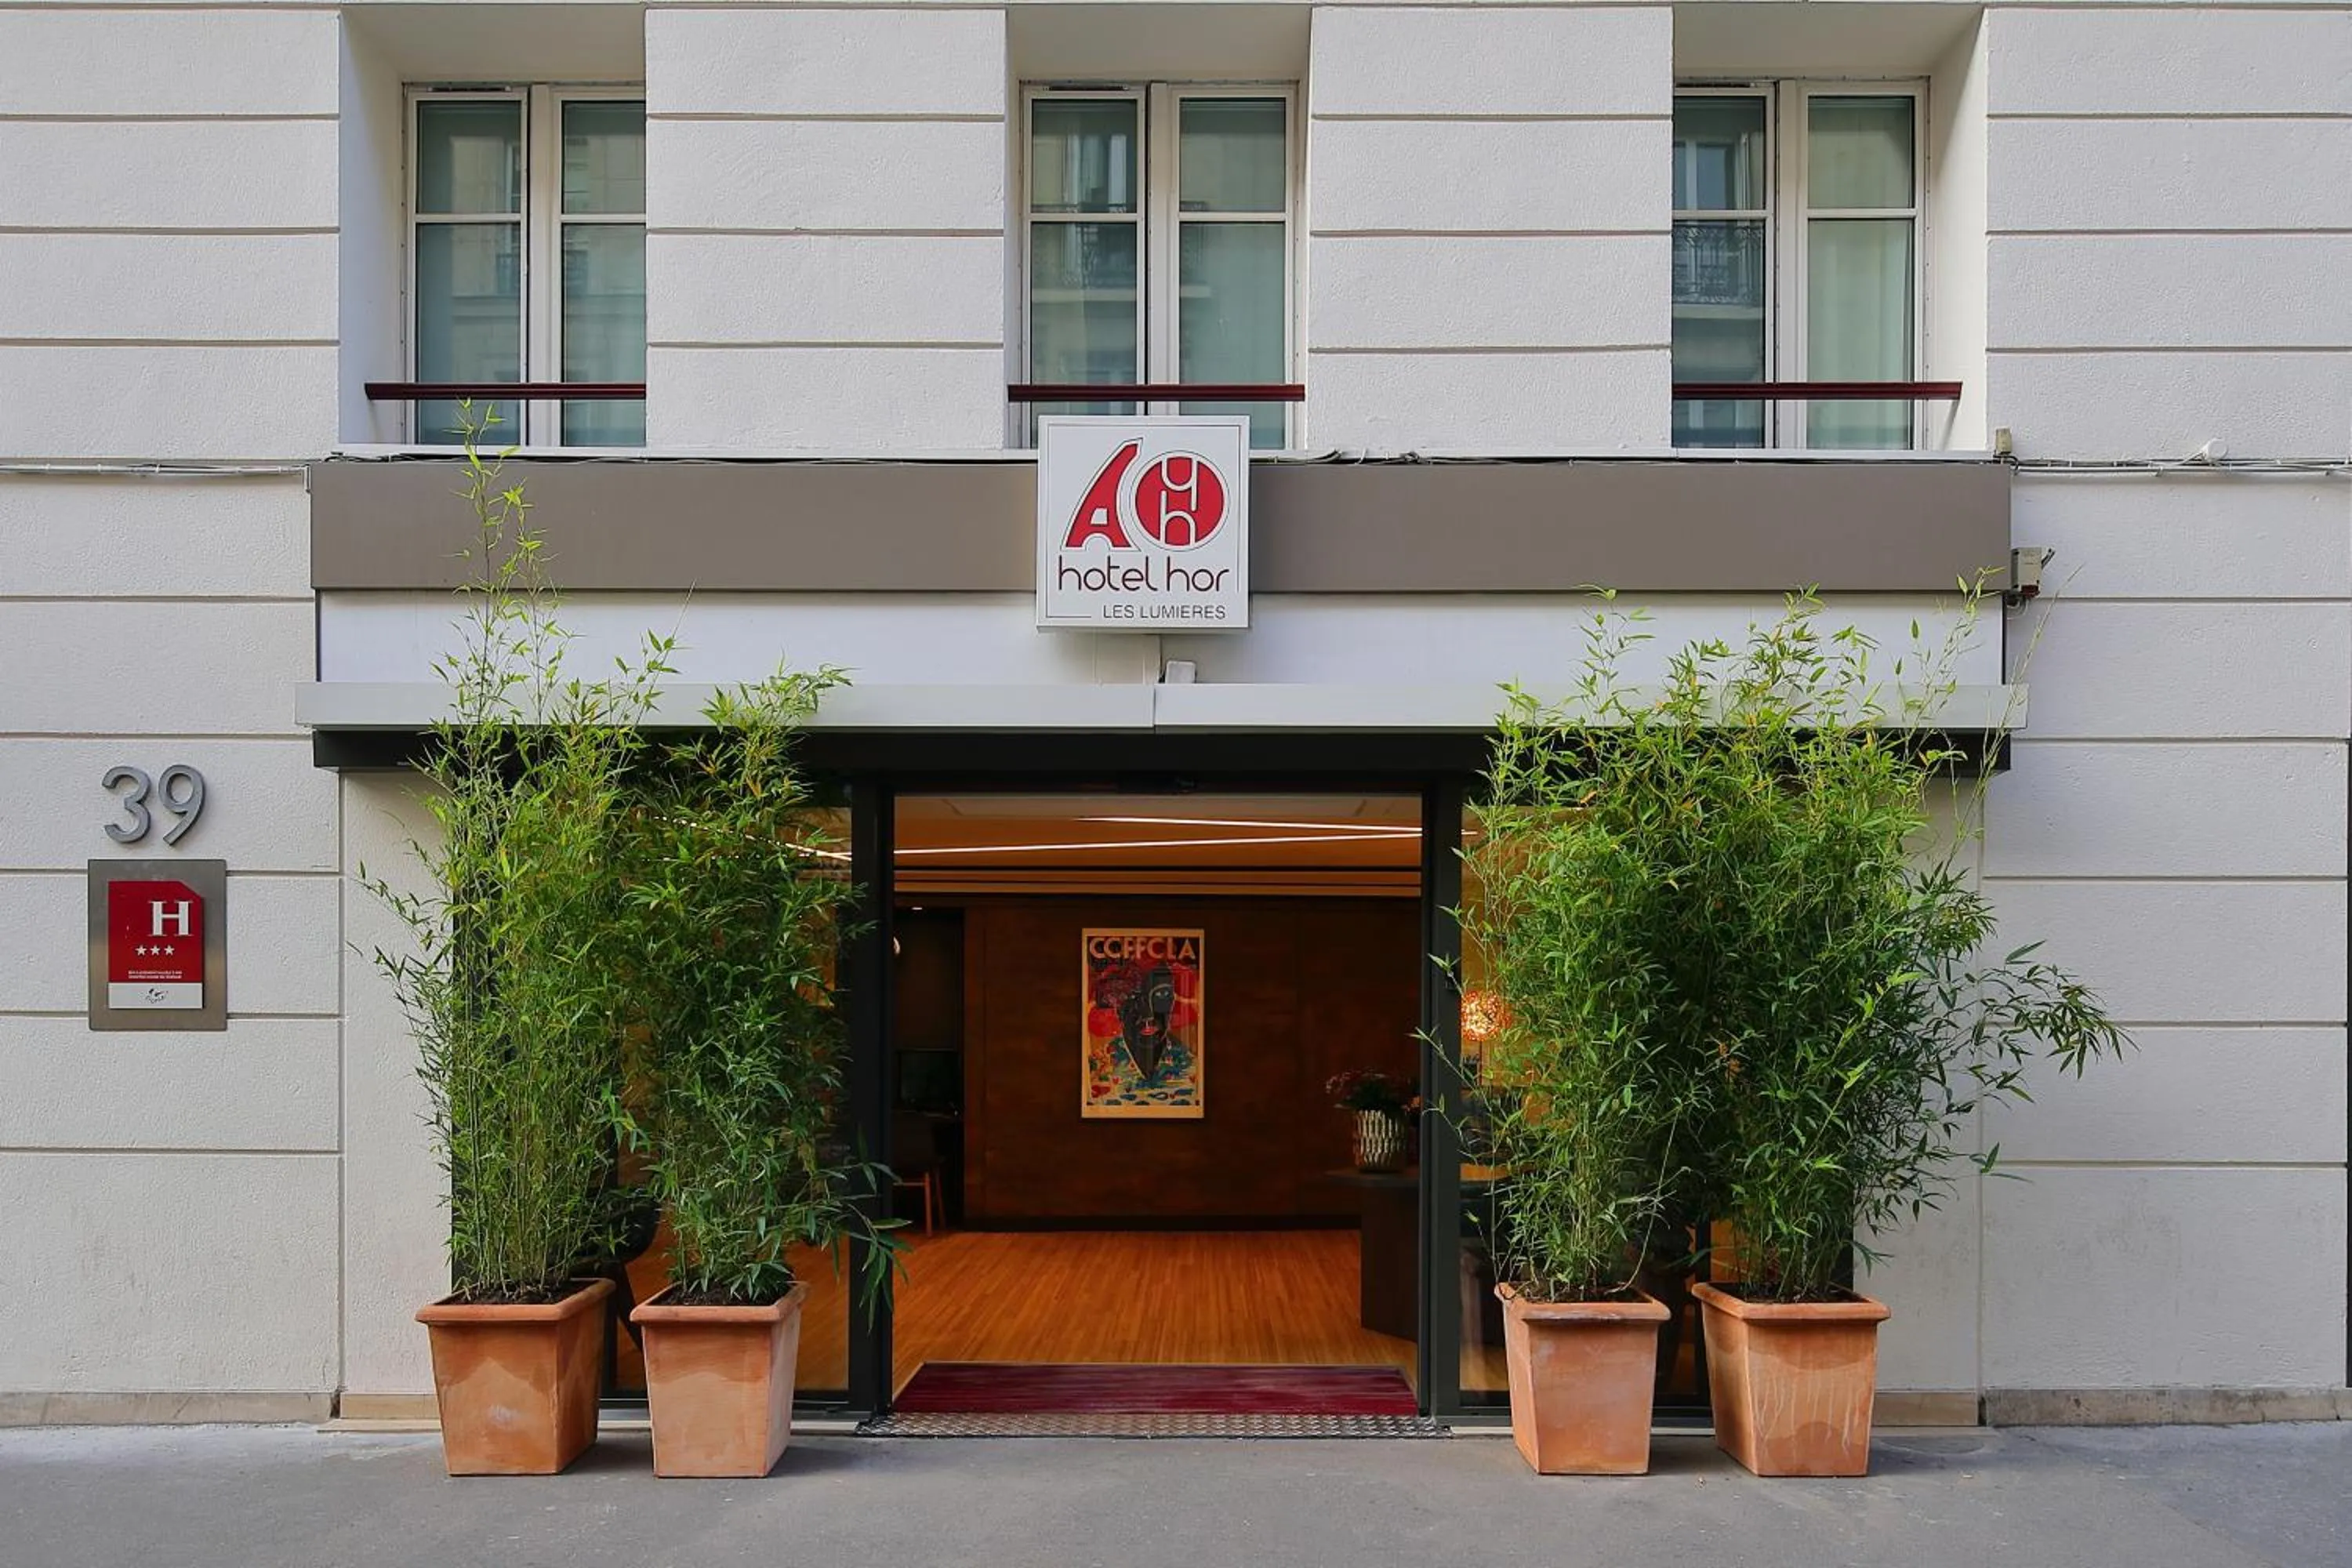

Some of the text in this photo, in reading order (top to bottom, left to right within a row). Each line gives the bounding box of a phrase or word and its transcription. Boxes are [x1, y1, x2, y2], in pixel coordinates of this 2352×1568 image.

[1058, 555, 1229, 591] hotel hor
[1103, 604, 1225, 619] LES LUMIERES
[102, 764, 205, 846] 39
[148, 901, 194, 937] H
